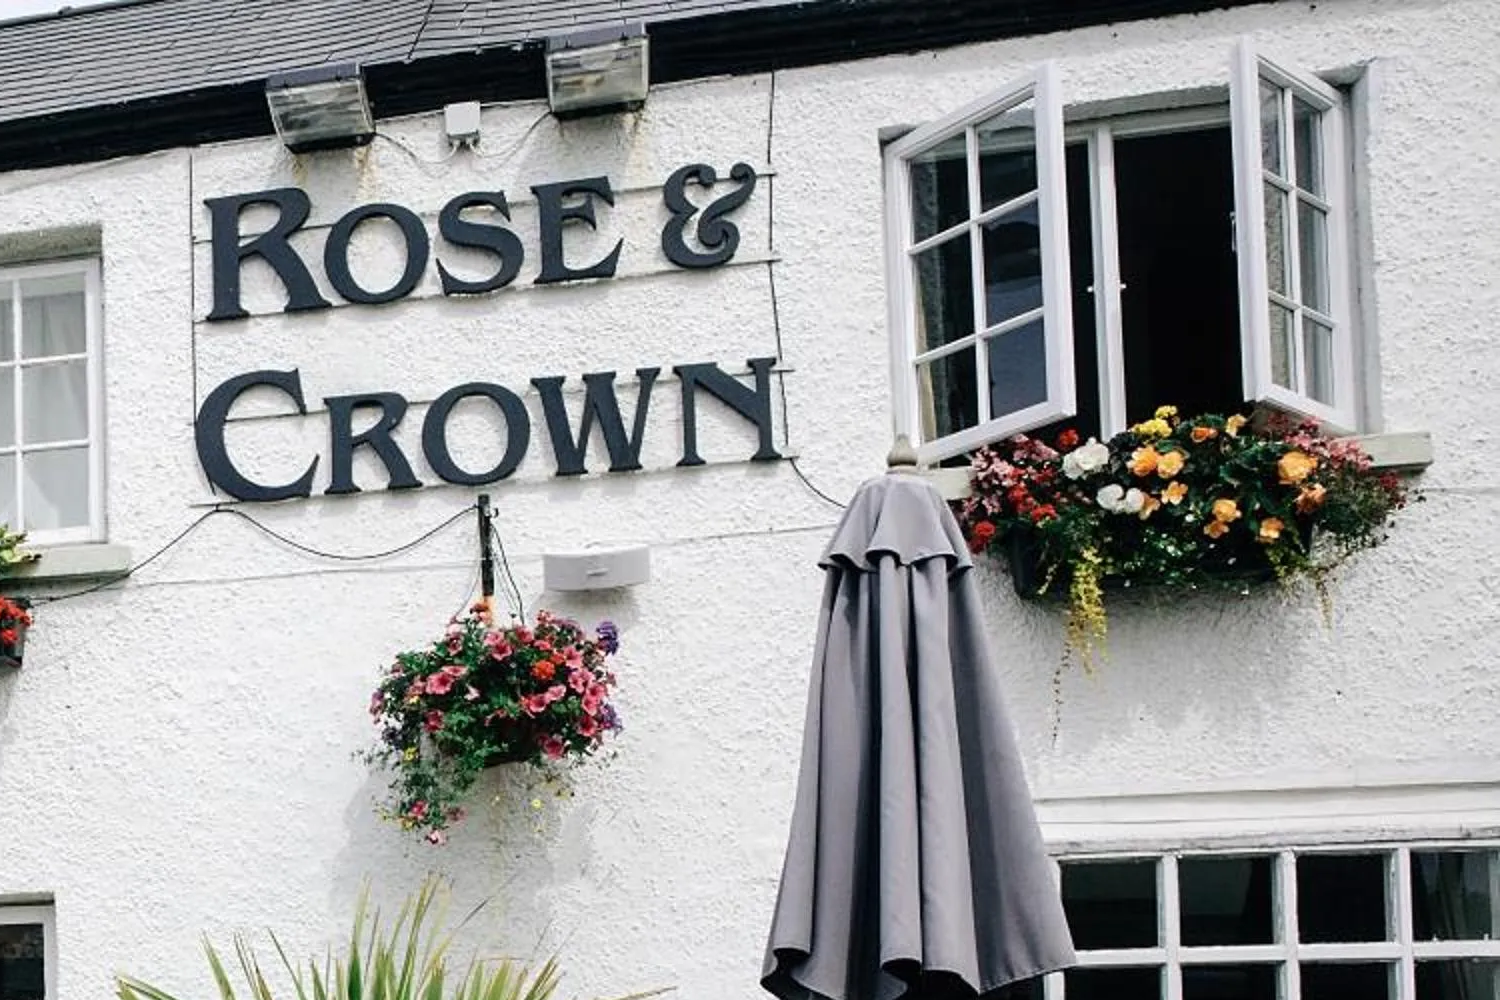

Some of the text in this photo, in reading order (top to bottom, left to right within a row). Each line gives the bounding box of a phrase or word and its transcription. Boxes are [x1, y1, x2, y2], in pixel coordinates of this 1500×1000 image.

[203, 162, 758, 322] ROSE &
[194, 357, 783, 502] CROWN
